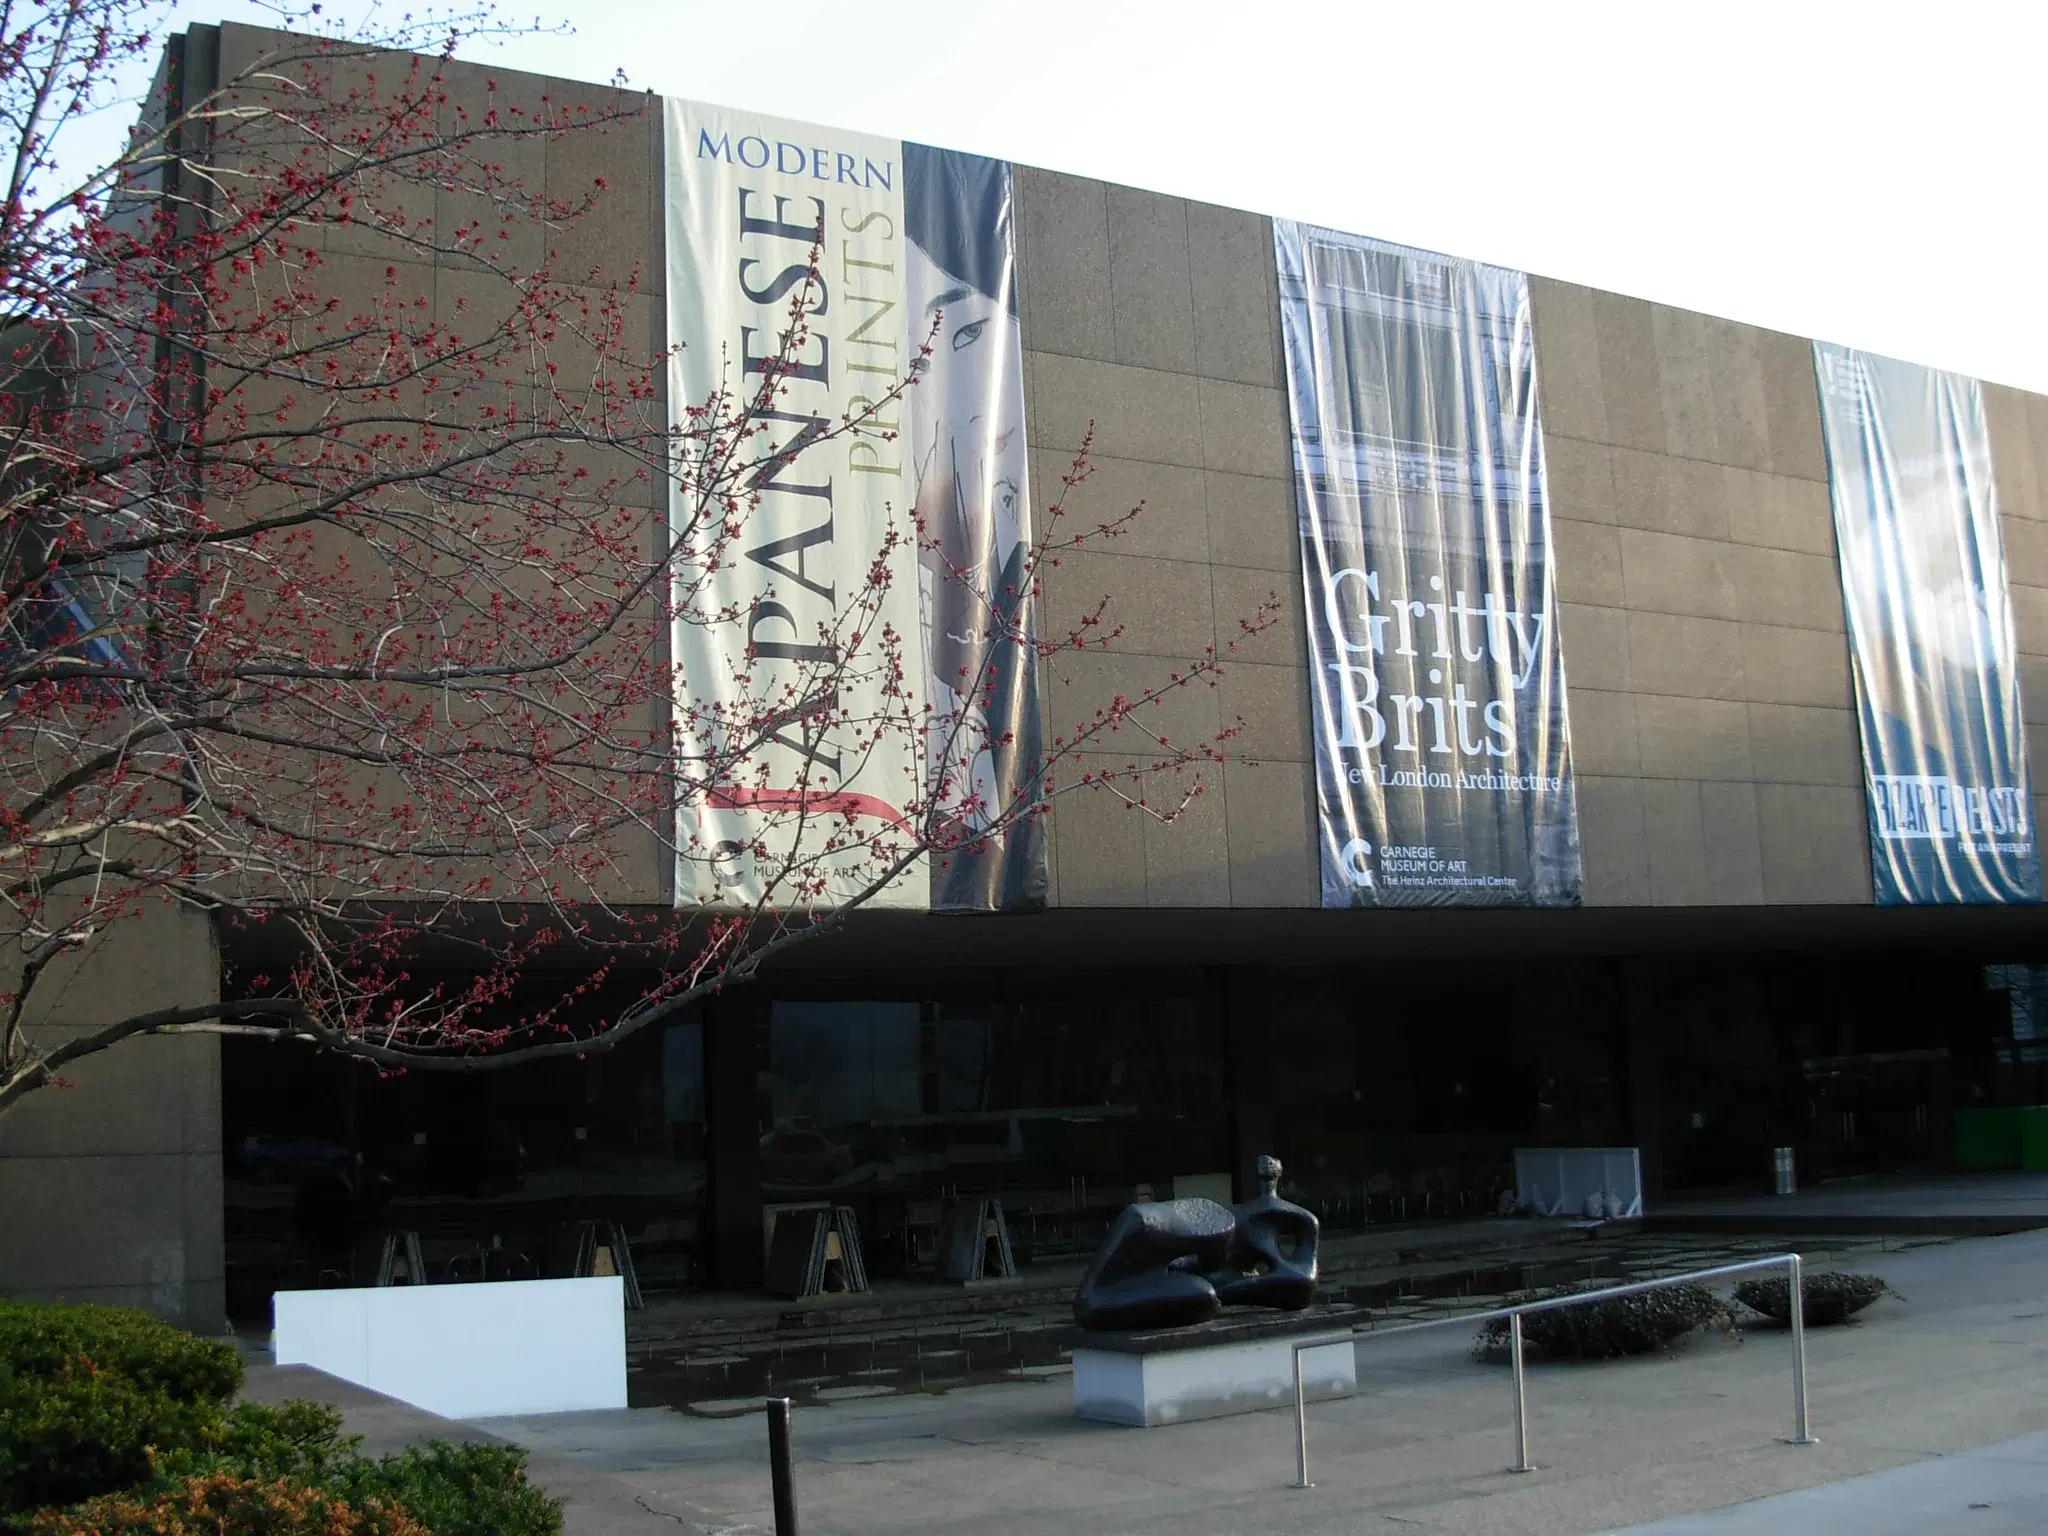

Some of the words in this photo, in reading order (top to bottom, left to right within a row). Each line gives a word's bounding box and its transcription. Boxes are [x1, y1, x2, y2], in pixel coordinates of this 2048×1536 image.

[696, 127, 893, 192] MODERN
[840, 206, 903, 478] PRINTS
[1325, 568, 1544, 689] Gritty
[1328, 663, 1517, 757] Brits
[1379, 763, 1450, 788] London
[1455, 767, 1561, 791] Architecture
[754, 852, 818, 864] CARNGIE
[1380, 846, 1436, 858] CARNEGIE
[812, 867, 829, 878] OF
[1381, 860, 1427, 872] MUSEUM
[1429, 861, 1446, 872] OF
[1447, 861, 1467, 872] ART
[1382, 875, 1398, 885] The
[1400, 875, 1425, 885] Heinz
[1426, 876, 1486, 886] Architectural
[1487, 876, 1517, 886] Center
